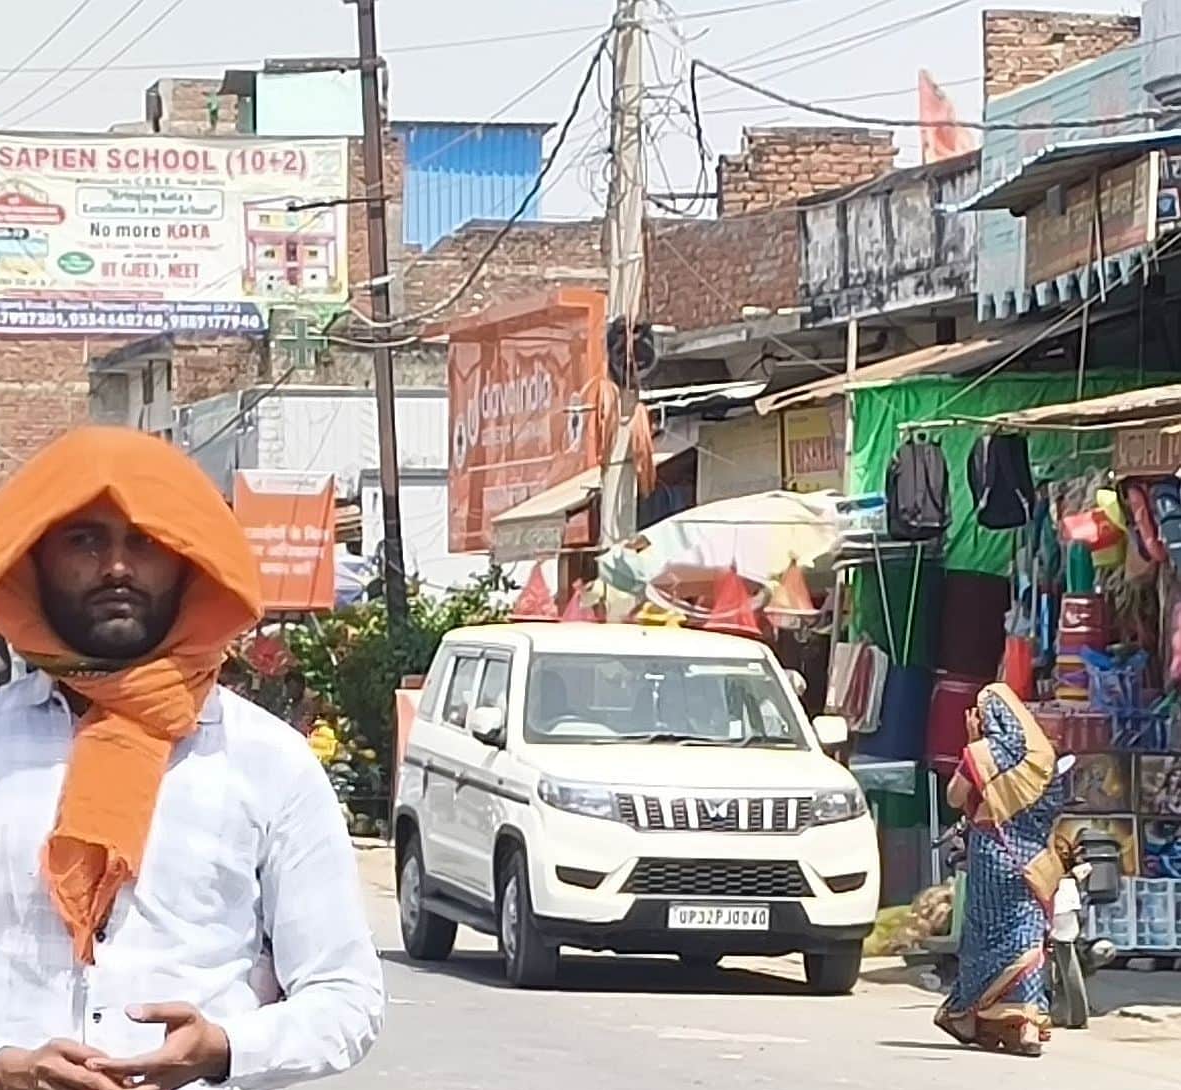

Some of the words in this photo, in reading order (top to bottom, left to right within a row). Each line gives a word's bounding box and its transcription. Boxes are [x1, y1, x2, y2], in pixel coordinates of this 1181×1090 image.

[106, 148, 217, 173] SCHOOL
[225, 149, 307, 181] (10+2)
[89, 221, 111, 238] No
[115, 225, 161, 238] more
[167, 223, 211, 240] KOTA
